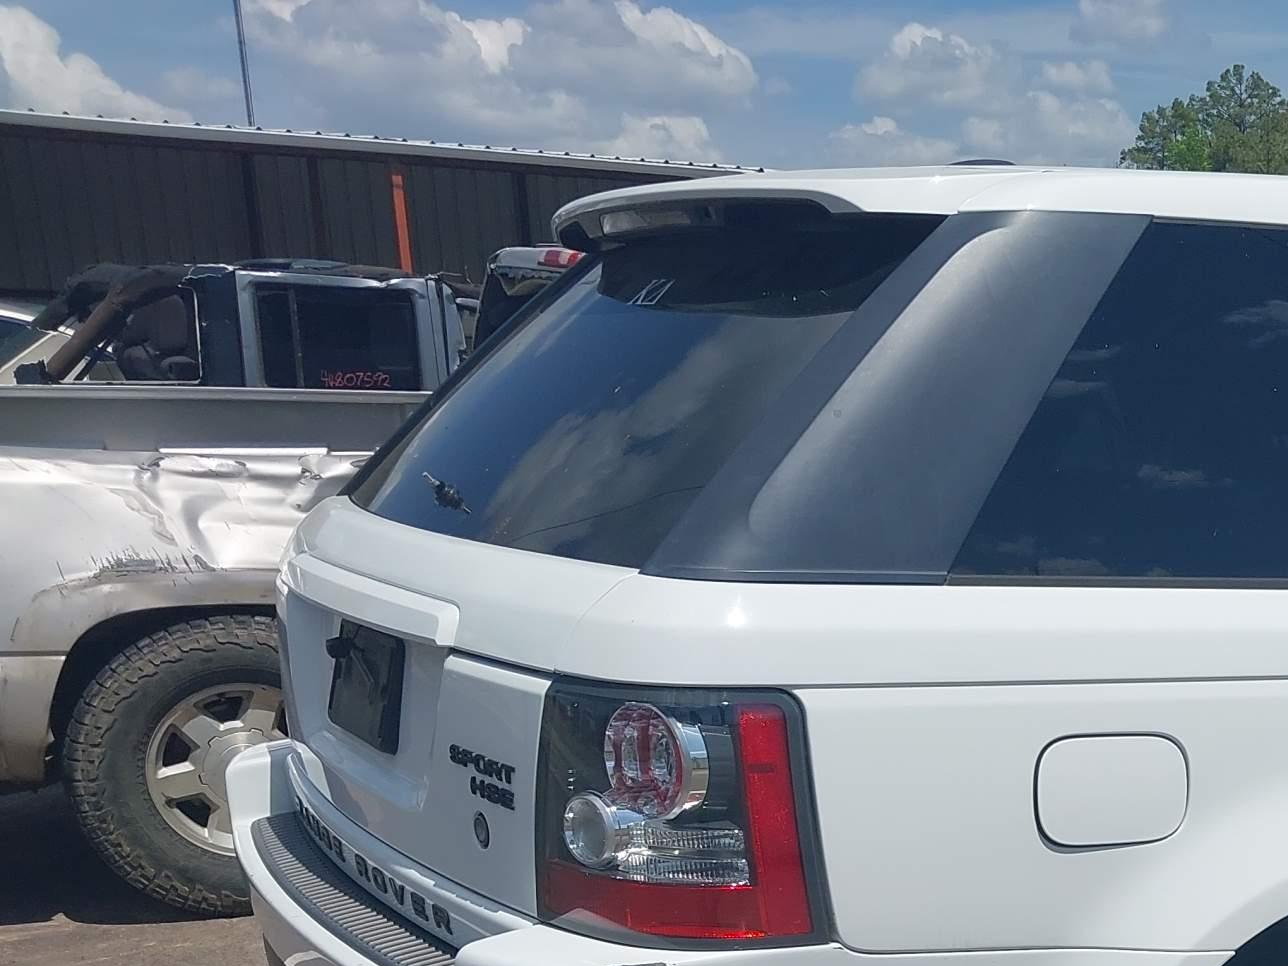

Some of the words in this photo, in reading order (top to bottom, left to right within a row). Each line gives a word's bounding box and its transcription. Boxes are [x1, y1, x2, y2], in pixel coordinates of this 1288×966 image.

[449, 744, 515, 785] SPORT
[470, 776, 515, 811] HSE
[353, 852, 454, 936] ROVER
